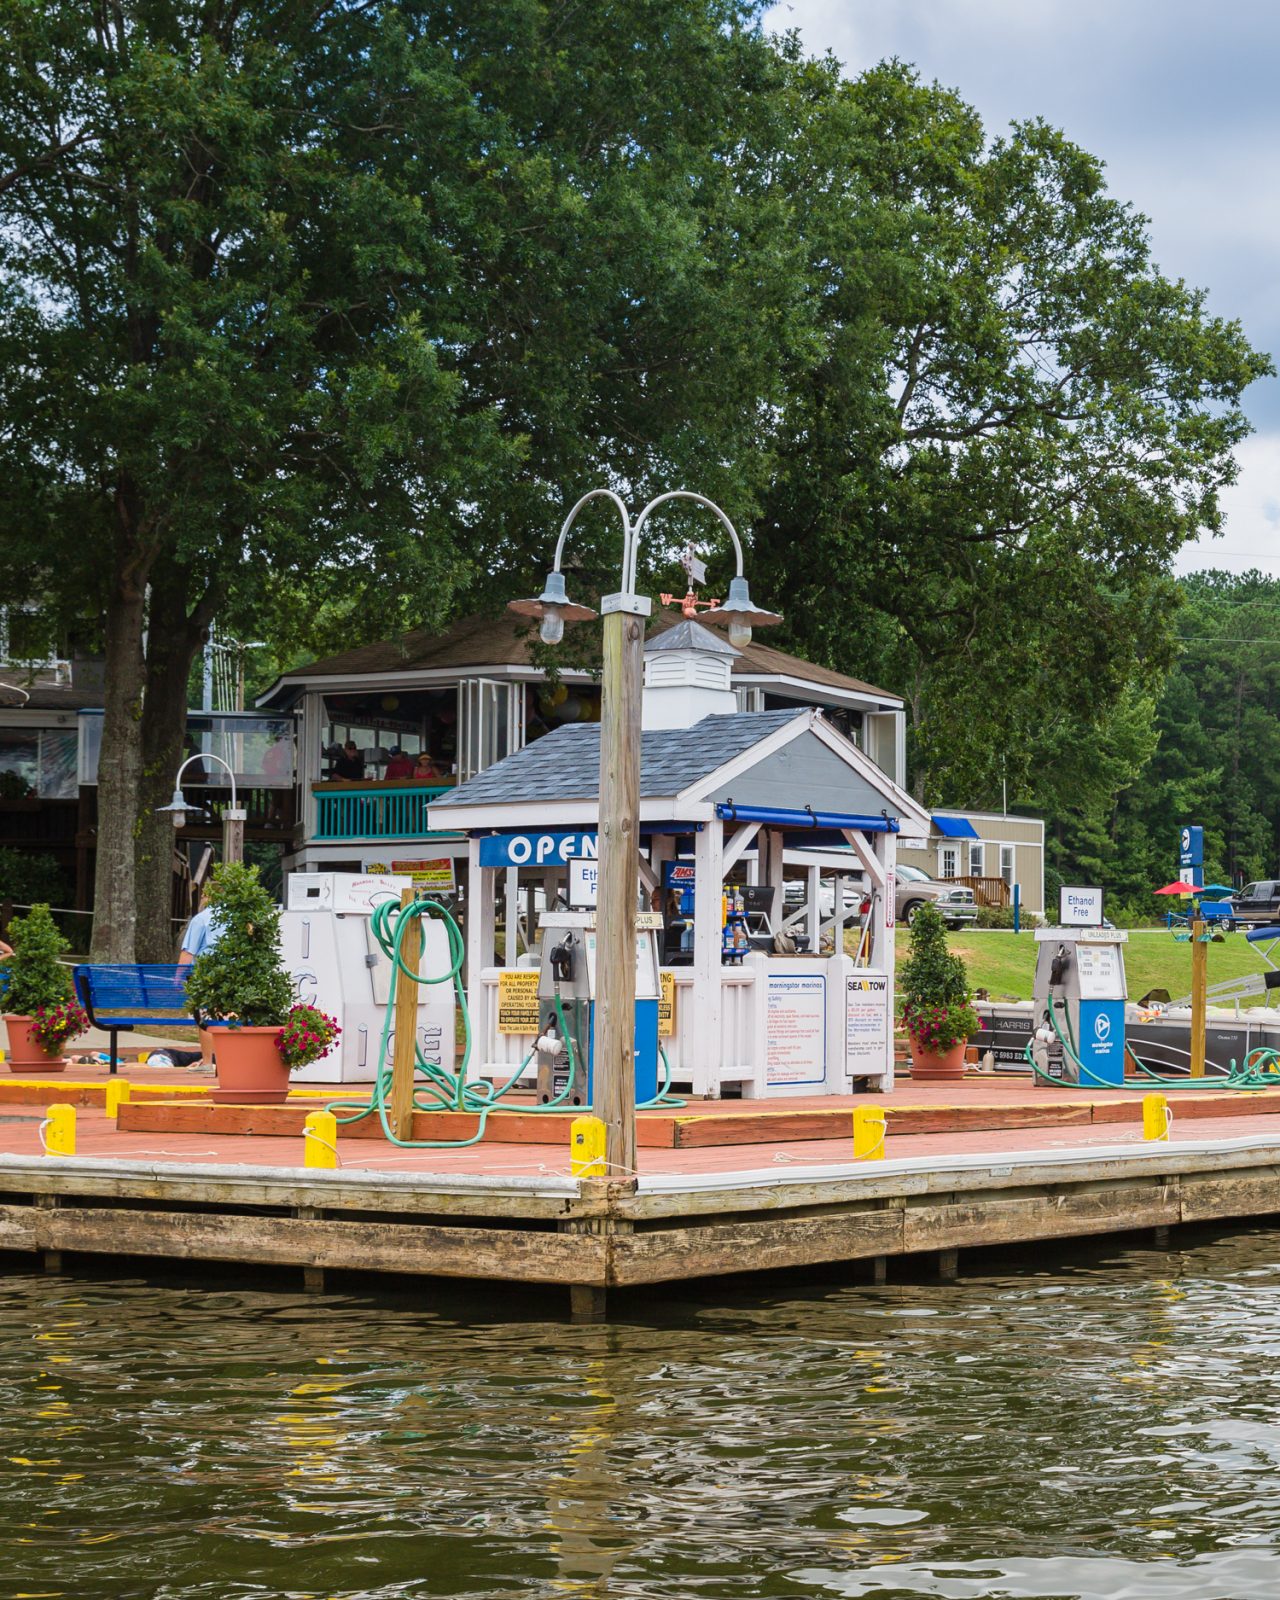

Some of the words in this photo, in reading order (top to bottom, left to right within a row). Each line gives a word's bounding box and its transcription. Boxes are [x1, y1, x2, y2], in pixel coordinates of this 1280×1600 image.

[508, 835, 598, 864] OPEN
[1068, 895, 1095, 906] Ethanol
[1074, 907, 1088, 916] Free
[768, 982, 800, 990] morningstar
[848, 982, 862, 990] SEA
[869, 982, 886, 990] TOW
[997, 1020, 1030, 1030] HARRIS
